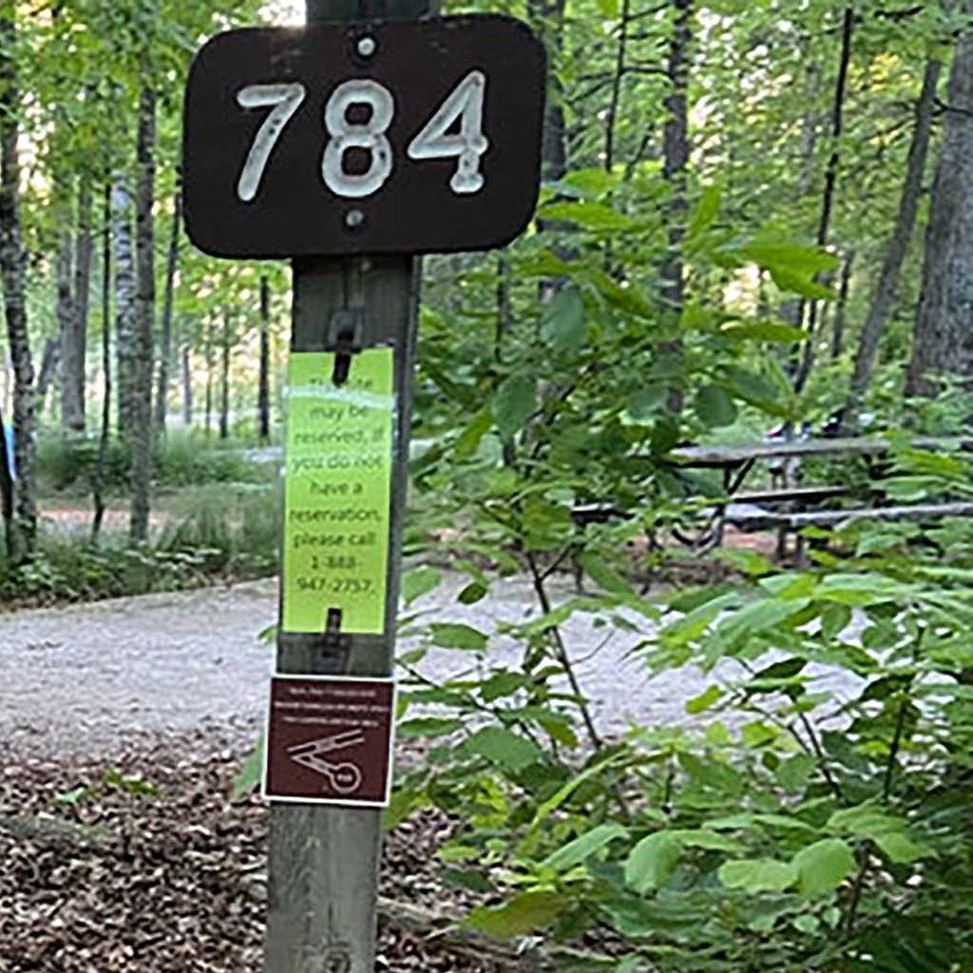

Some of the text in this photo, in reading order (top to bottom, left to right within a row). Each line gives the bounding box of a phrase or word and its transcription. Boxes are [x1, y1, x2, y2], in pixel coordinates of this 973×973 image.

[236, 69, 489, 202] 784
[291, 456, 325, 474] you
[328, 452, 350, 469] do
[310, 480, 363, 497] have a
[293, 532, 376, 549] please call
